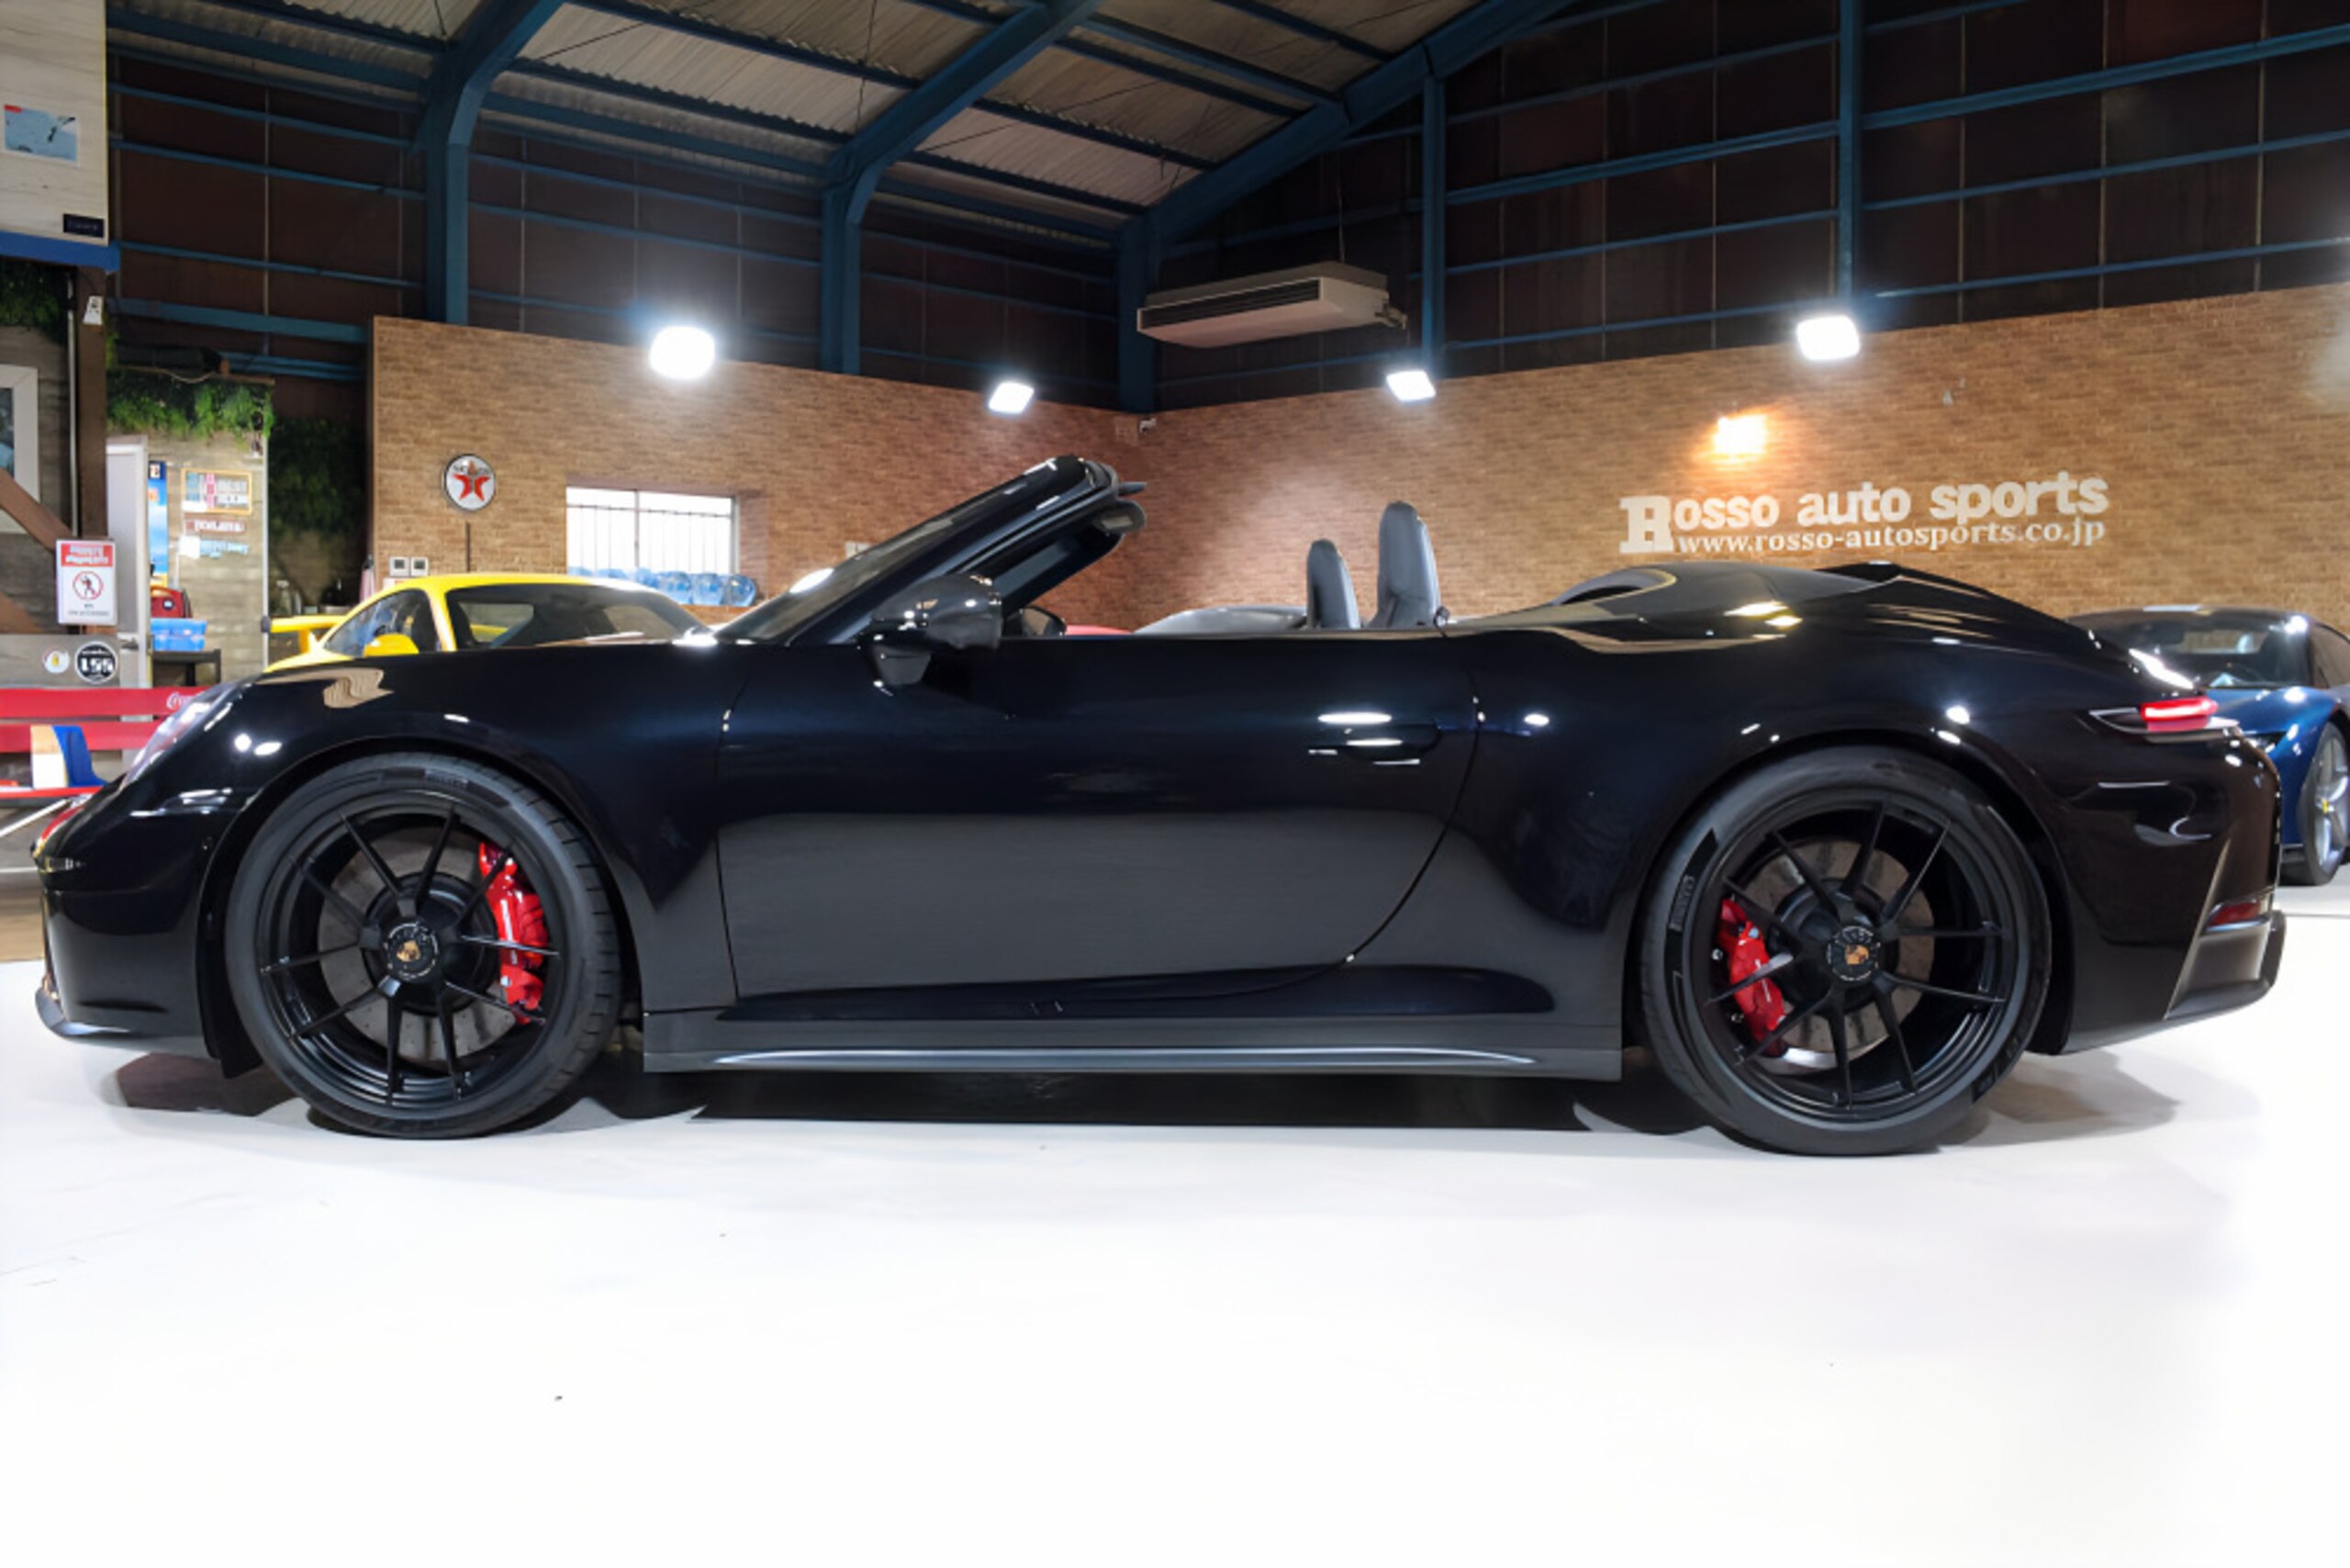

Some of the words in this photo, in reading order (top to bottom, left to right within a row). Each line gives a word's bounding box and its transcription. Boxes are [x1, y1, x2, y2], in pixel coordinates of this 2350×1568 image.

[1619, 493, 1780, 554] Rosso
[1796, 481, 1911, 527] auto
[1929, 470, 2109, 524] sports
[1675, 516, 2105, 553] www.rosso-autosports.co.jp
